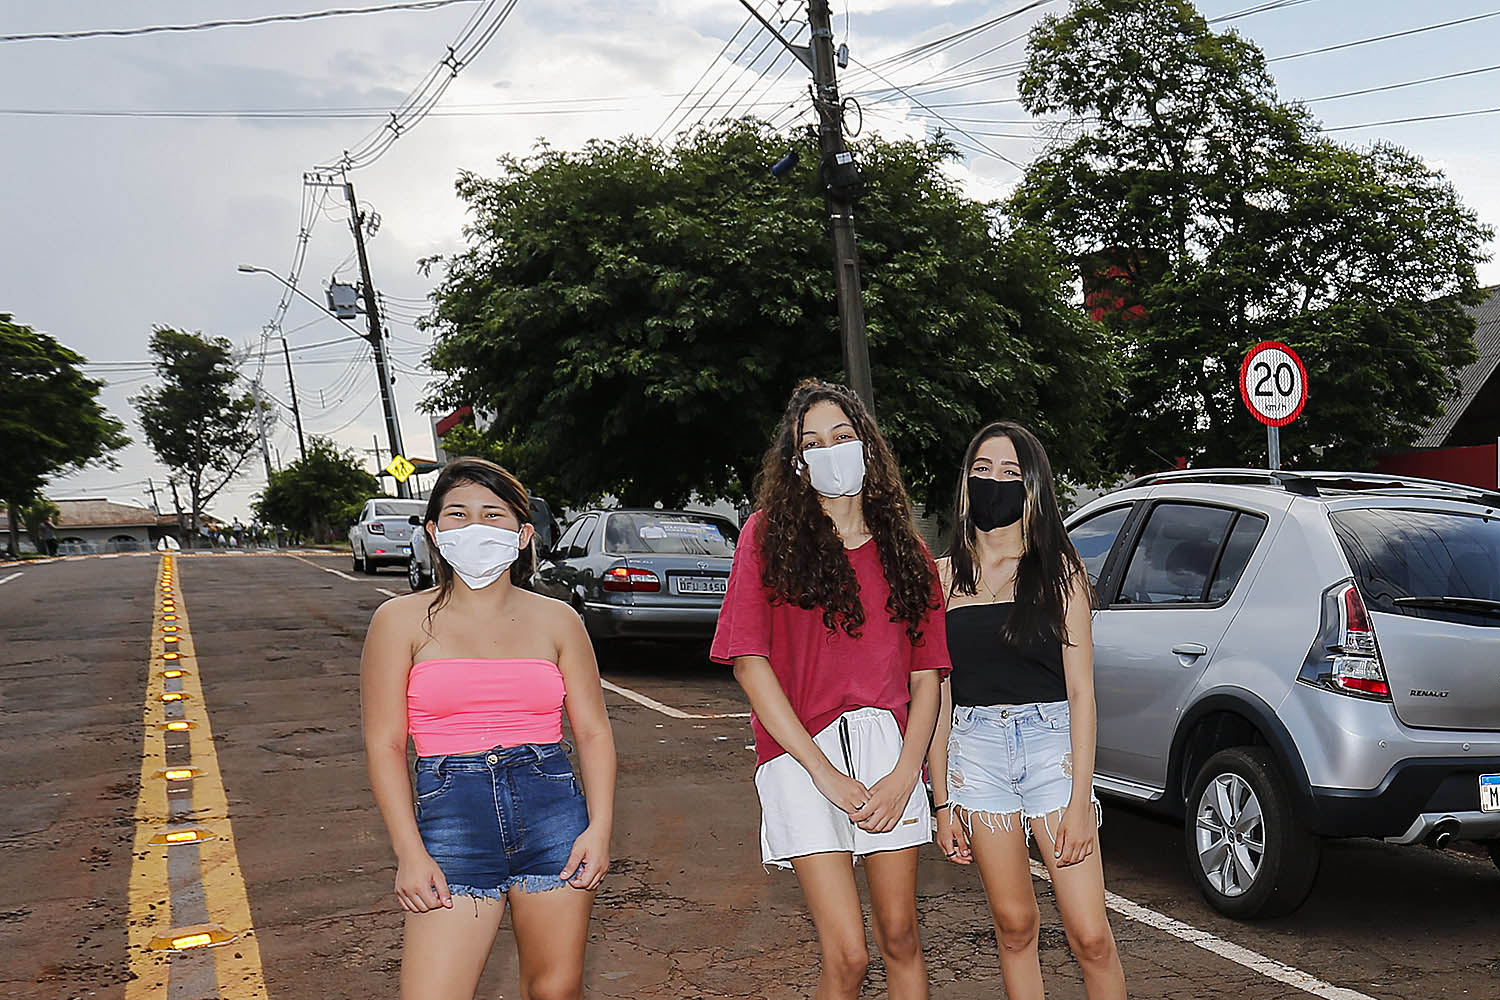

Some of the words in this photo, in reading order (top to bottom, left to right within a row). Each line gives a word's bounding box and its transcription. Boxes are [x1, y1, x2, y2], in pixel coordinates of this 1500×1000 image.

[1254, 361, 1295, 397] 20
[1265, 403, 1287, 412] km/h
[1409, 689, 1449, 698] RENAULT
